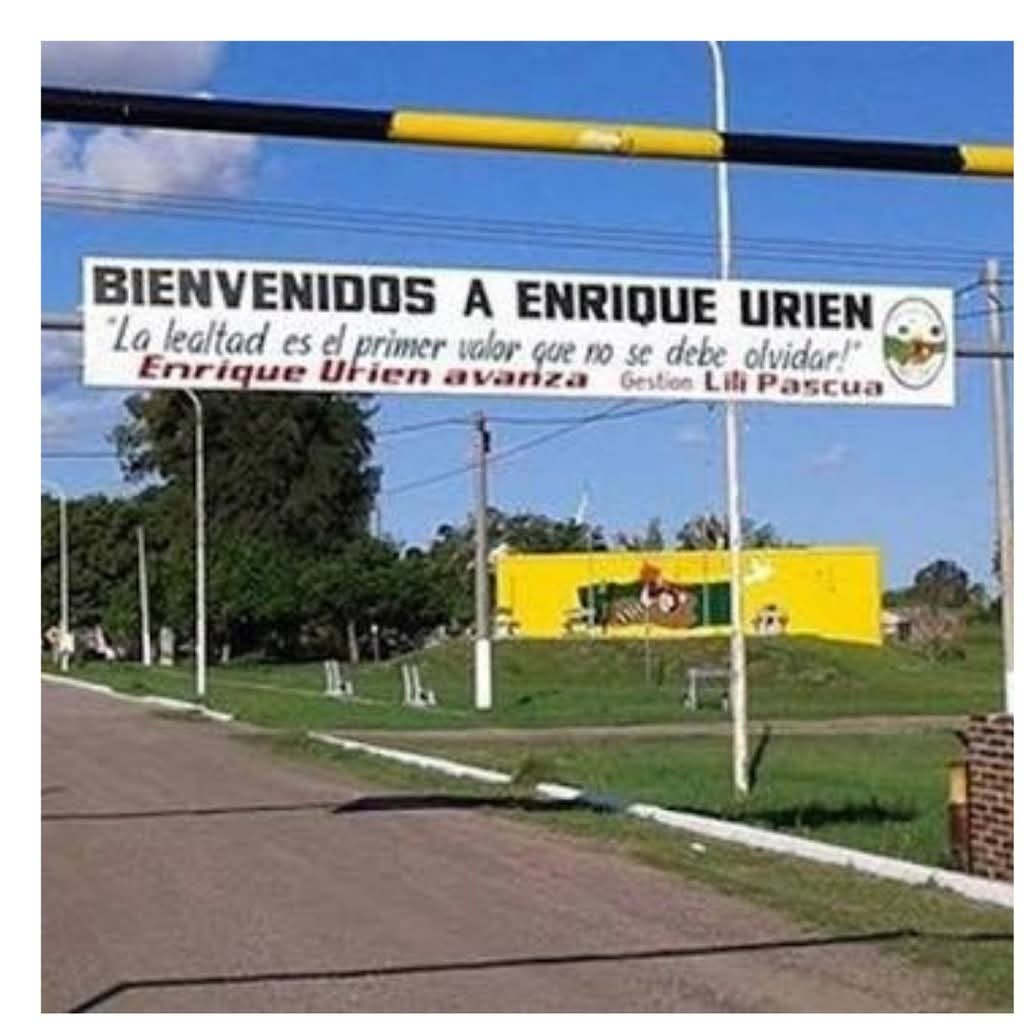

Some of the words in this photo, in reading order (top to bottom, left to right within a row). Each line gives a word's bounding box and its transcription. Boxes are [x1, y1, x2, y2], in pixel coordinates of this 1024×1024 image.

[92, 265, 436, 315] BIENVENIDOS
[462, 277, 494, 318] A
[516, 280, 718, 326] ENRIQUE
[739, 288, 874, 330] URIEN
[163, 316, 271, 356] lealtad
[282, 332, 312, 356] es
[321, 322, 346, 358] el
[351, 328, 447, 372] primer
[458, 327, 522, 362] valor
[530, 339, 577, 373] que
[584, 338, 614, 367] no
[624, 343, 655, 367] se
[666, 336, 729, 368] debe
[137, 353, 308, 389] Enrique
[318, 358, 433, 387] Urien
[442, 366, 589, 389] avanza
[757, 372, 885, 398] Pascua
